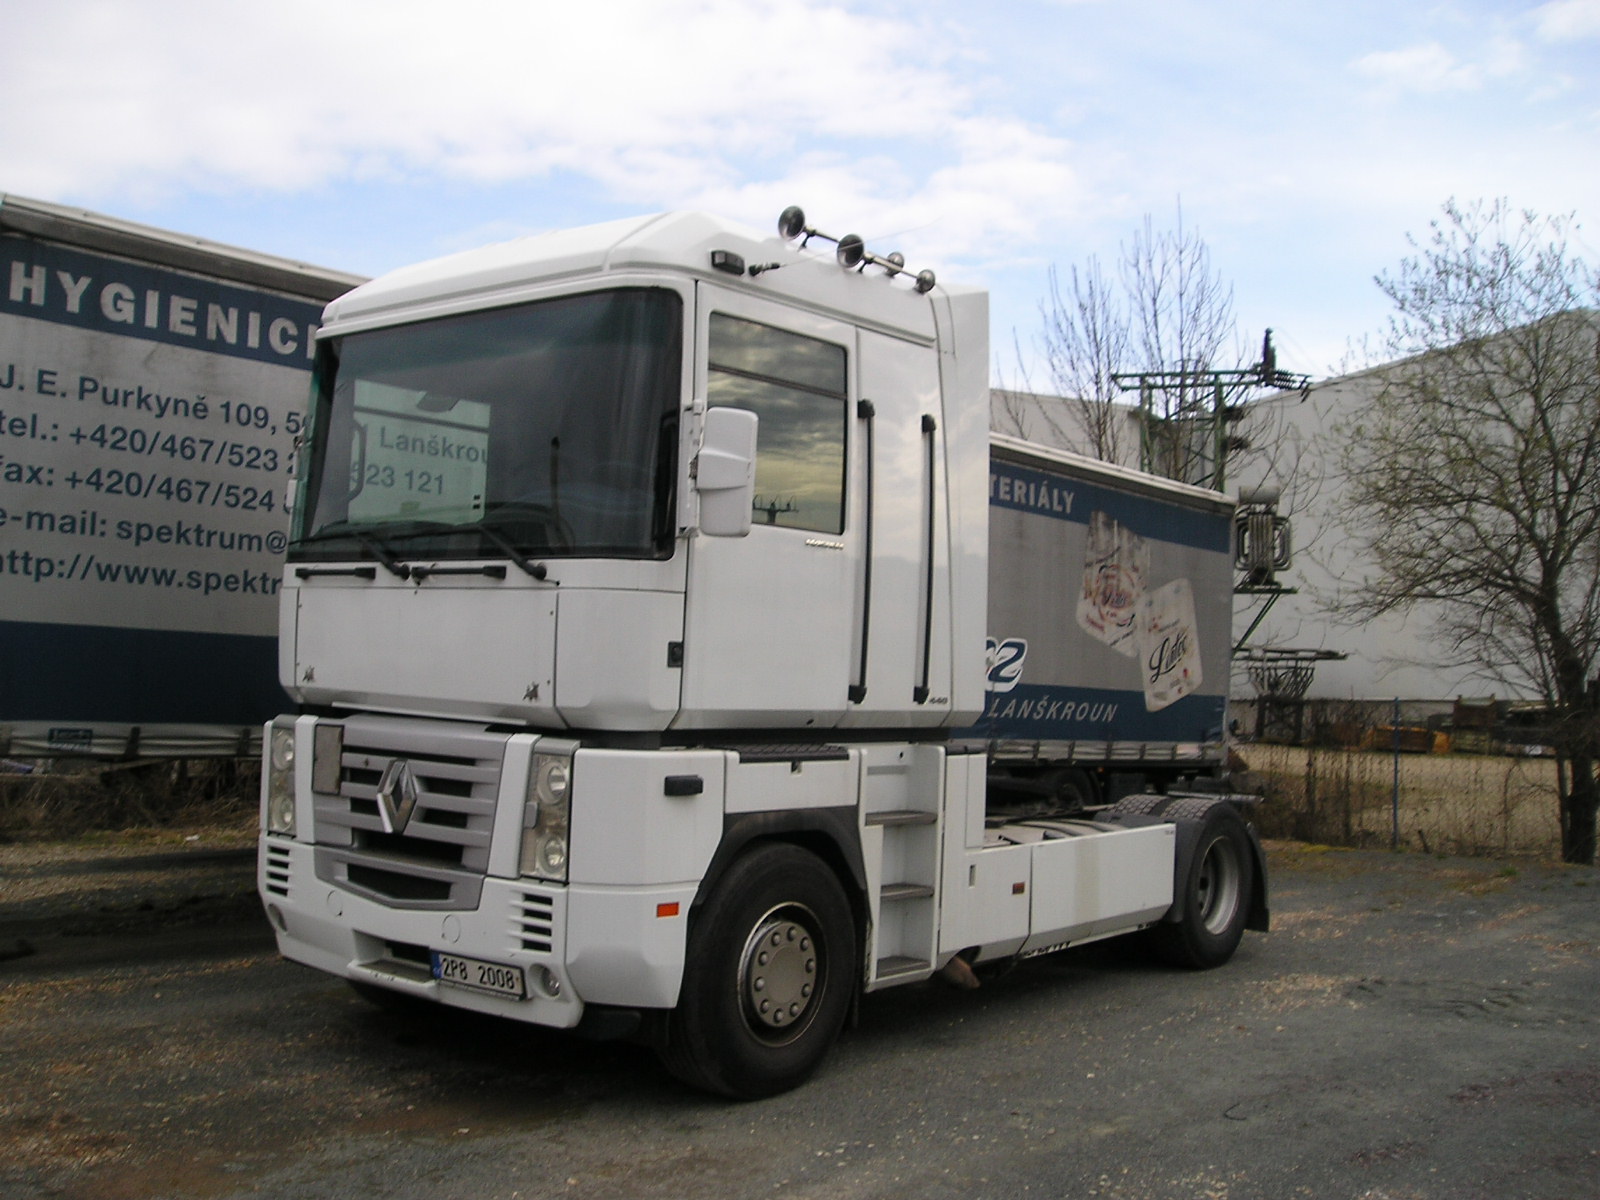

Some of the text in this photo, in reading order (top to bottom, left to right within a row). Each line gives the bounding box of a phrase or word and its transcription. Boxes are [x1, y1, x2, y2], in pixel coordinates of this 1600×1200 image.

[0, 364, 25, 391] J.
[37, 369, 67, 398] E.
[78, 375, 209, 420] Purkyně
[219, 401, 277, 435] 109,
[69, 423, 279, 473] +420/467/523
[65, 467, 275, 513] +420/467/524
[404, 469, 444, 495] 121
[116, 520, 287, 555] spektrum@
[0, 549, 282, 596] ttp://www.spektr
[987, 694, 1119, 723] LANŠKROUN
[441, 957, 516, 990] 2P8 2008
